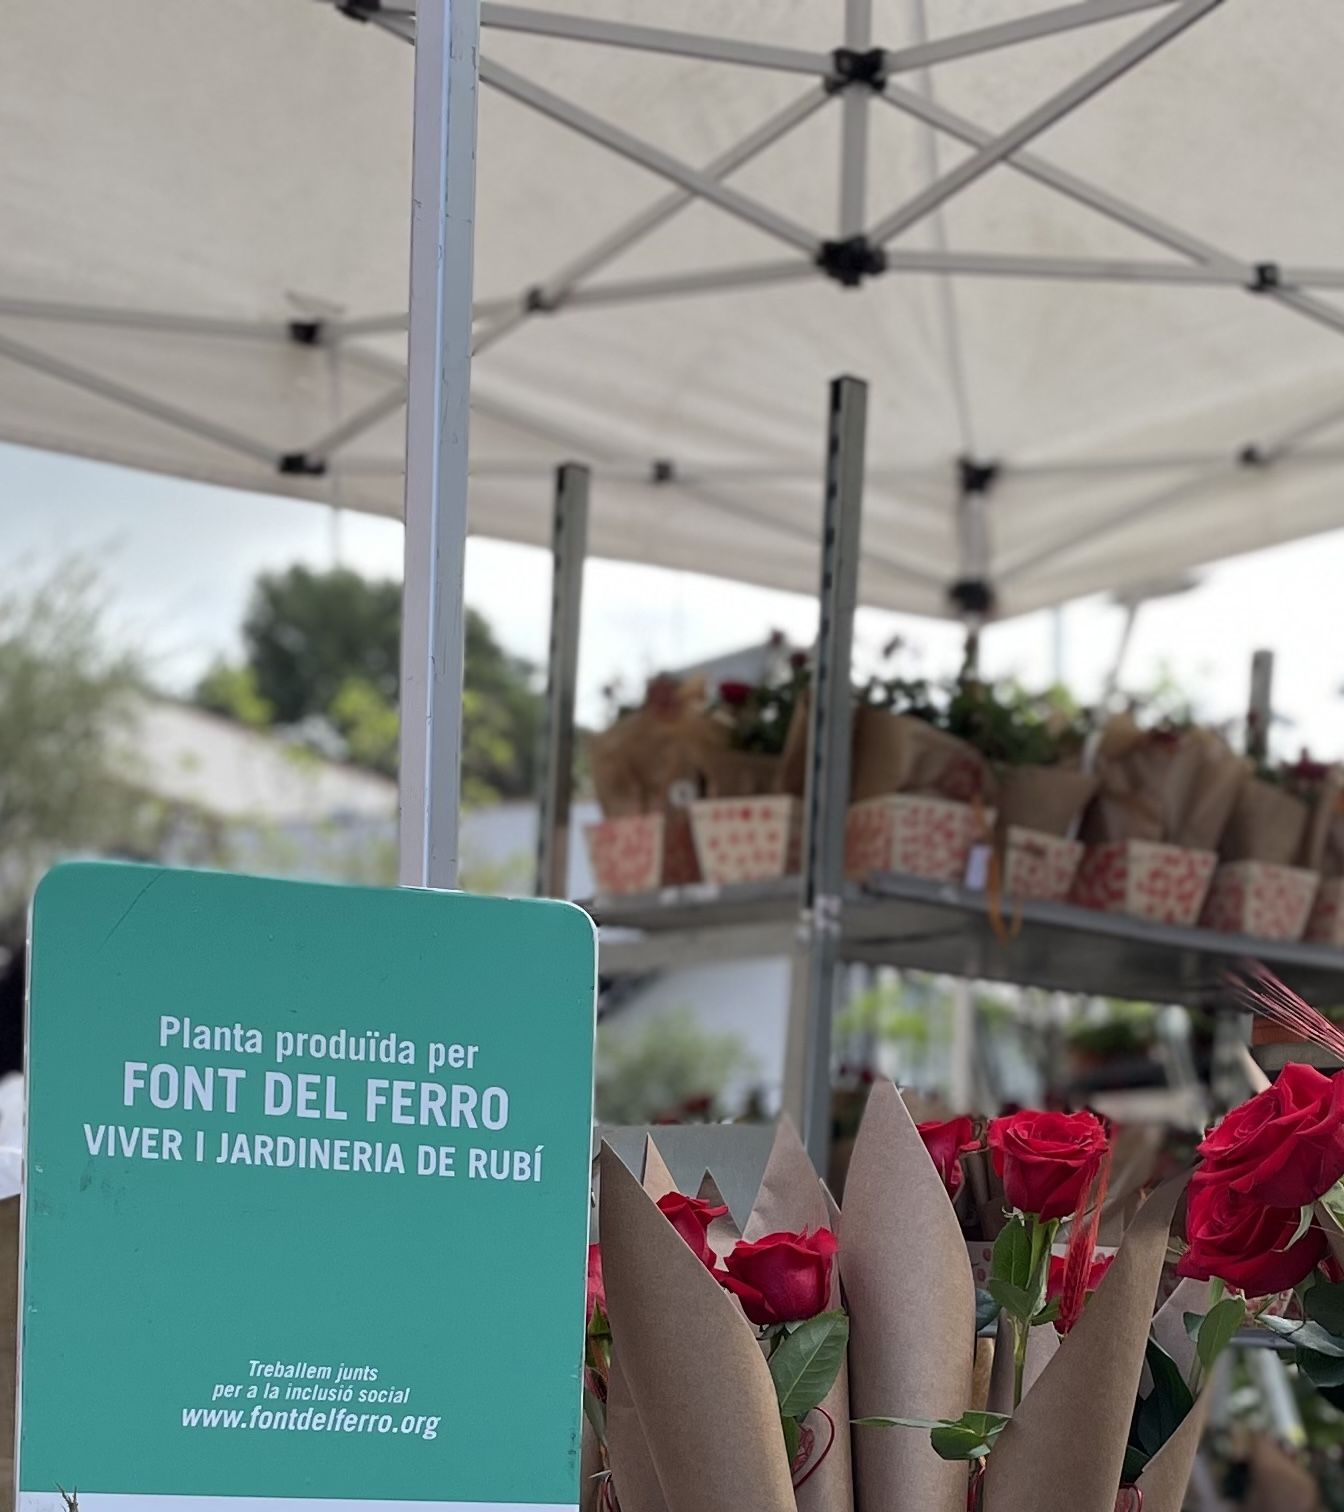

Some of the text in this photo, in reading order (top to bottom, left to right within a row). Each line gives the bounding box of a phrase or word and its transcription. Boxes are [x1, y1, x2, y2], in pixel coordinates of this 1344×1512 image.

[159, 1015, 479, 1073] Planta produïda per
[122, 1060, 510, 1131] FONT DEL FERRO
[82, 1123, 545, 1183] VIVER I JARDINERIA DE RUBÍ
[212, 1382, 411, 1404] per a la inclusió social
[248, 1360, 379, 1384] Treballem junts
[181, 1405, 441, 1440] www.fontdelferro.org
